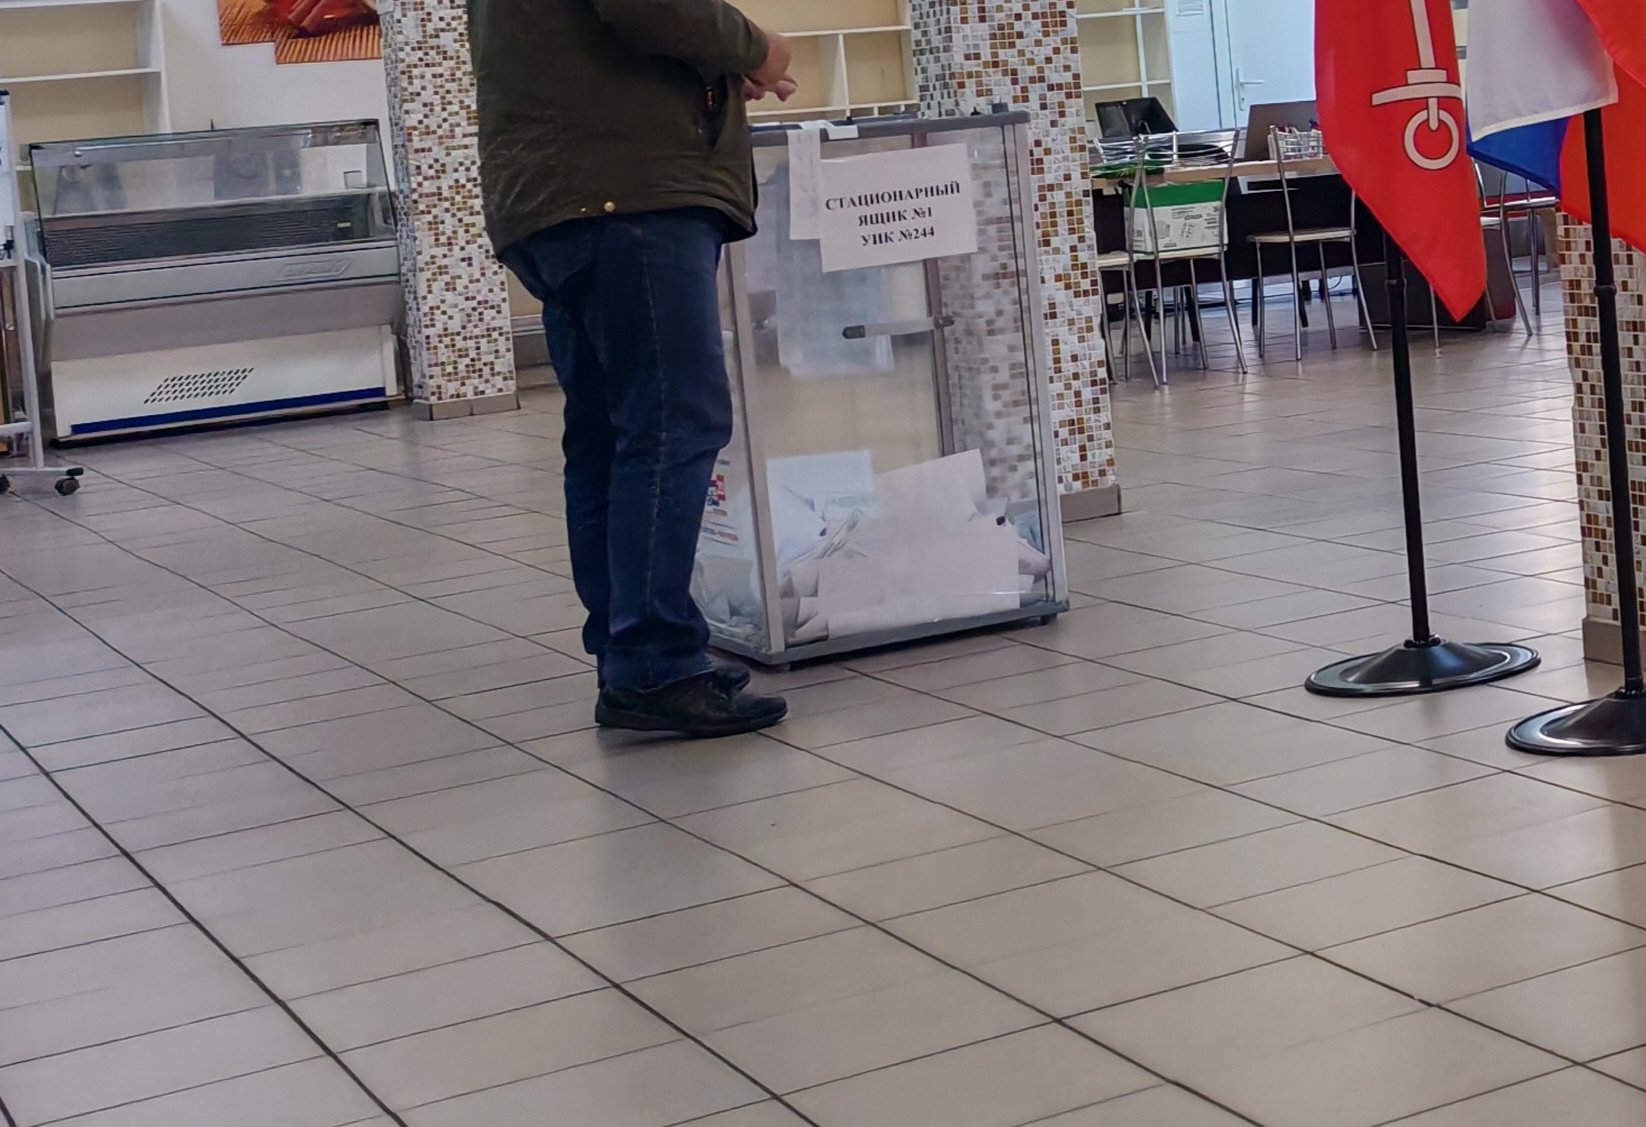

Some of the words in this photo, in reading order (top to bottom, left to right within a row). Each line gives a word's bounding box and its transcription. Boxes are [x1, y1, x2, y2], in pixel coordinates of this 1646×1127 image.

[825, 180, 961, 211] СТАЦИОНАРНЫЙ
[858, 209, 908, 228] ЯЩИК
[911, 206, 933, 220] №1
[861, 231, 895, 247] УИК
[898, 226, 936, 243] №244
